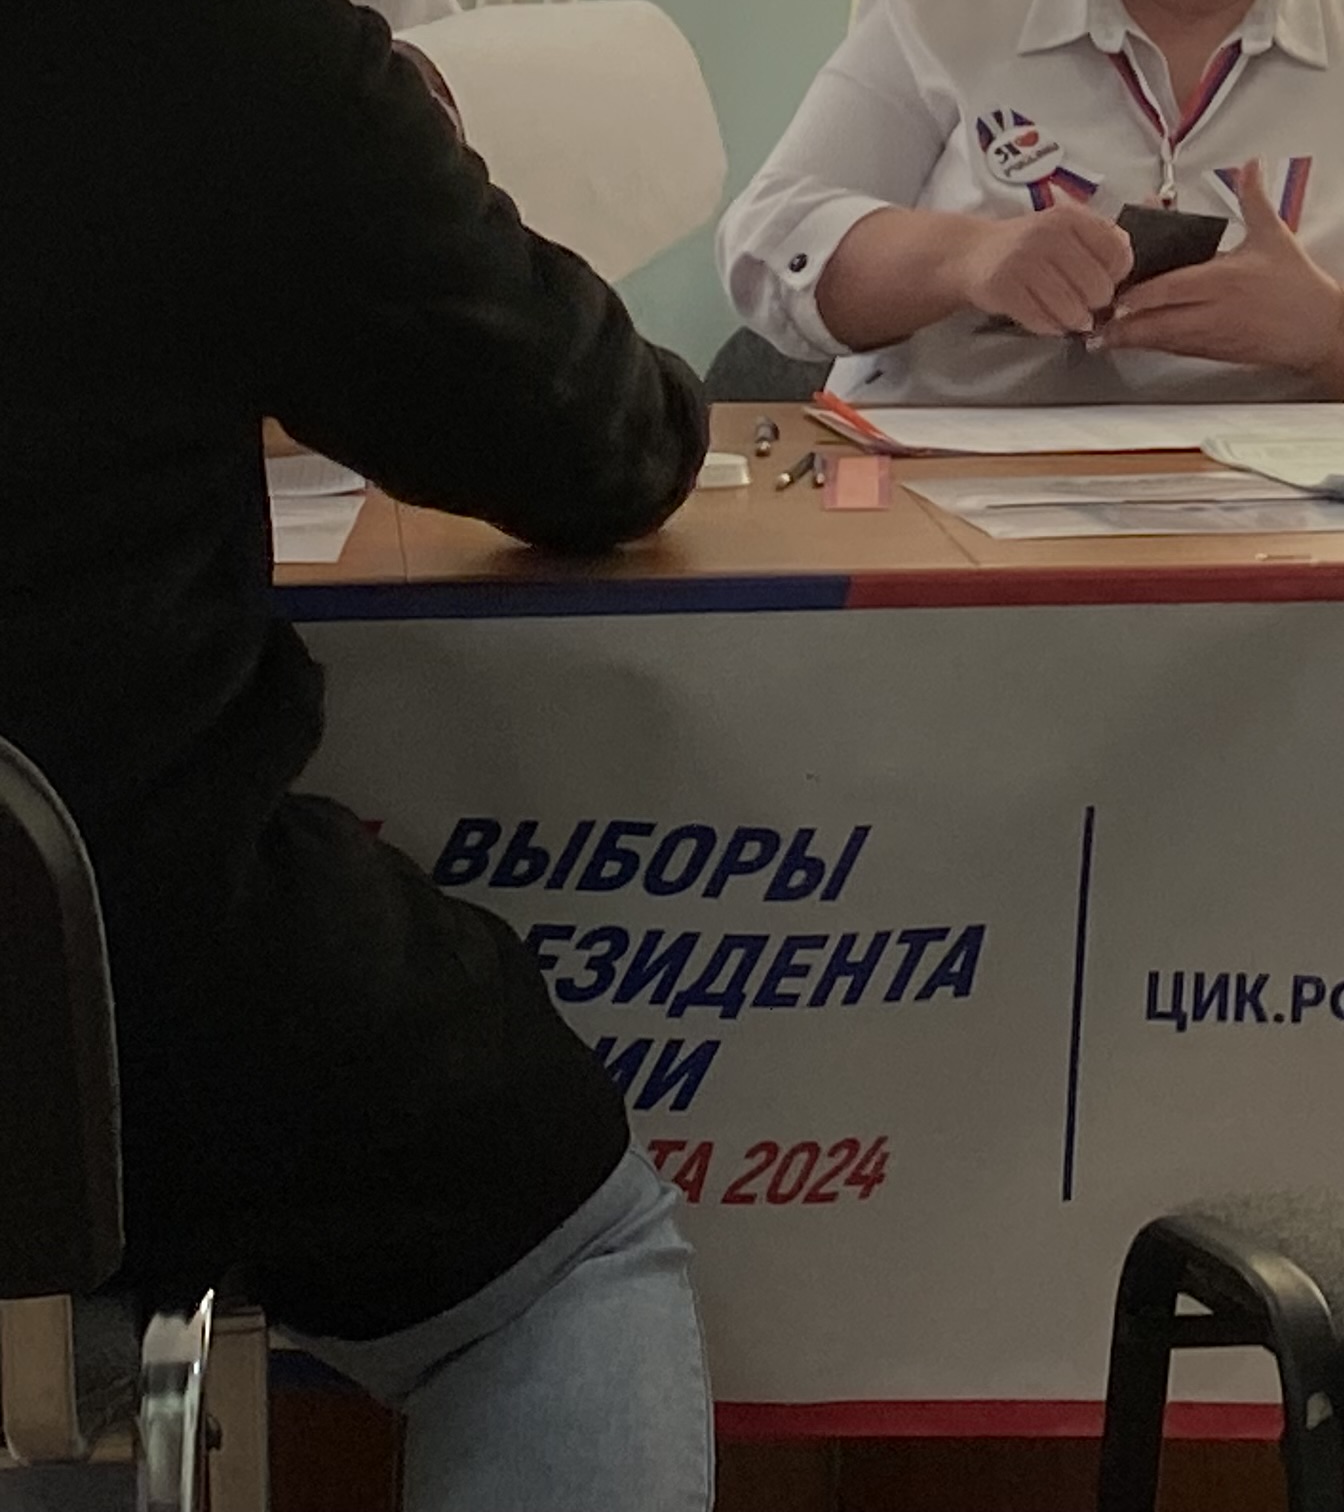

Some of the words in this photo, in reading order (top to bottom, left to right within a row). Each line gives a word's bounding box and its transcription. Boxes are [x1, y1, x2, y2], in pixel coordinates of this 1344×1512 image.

[432, 818, 872, 903] ВЫБОРЫ
[522, 922, 986, 1019] ЕЗИДЕНТА
[721, 1136, 889, 1205] 2024
